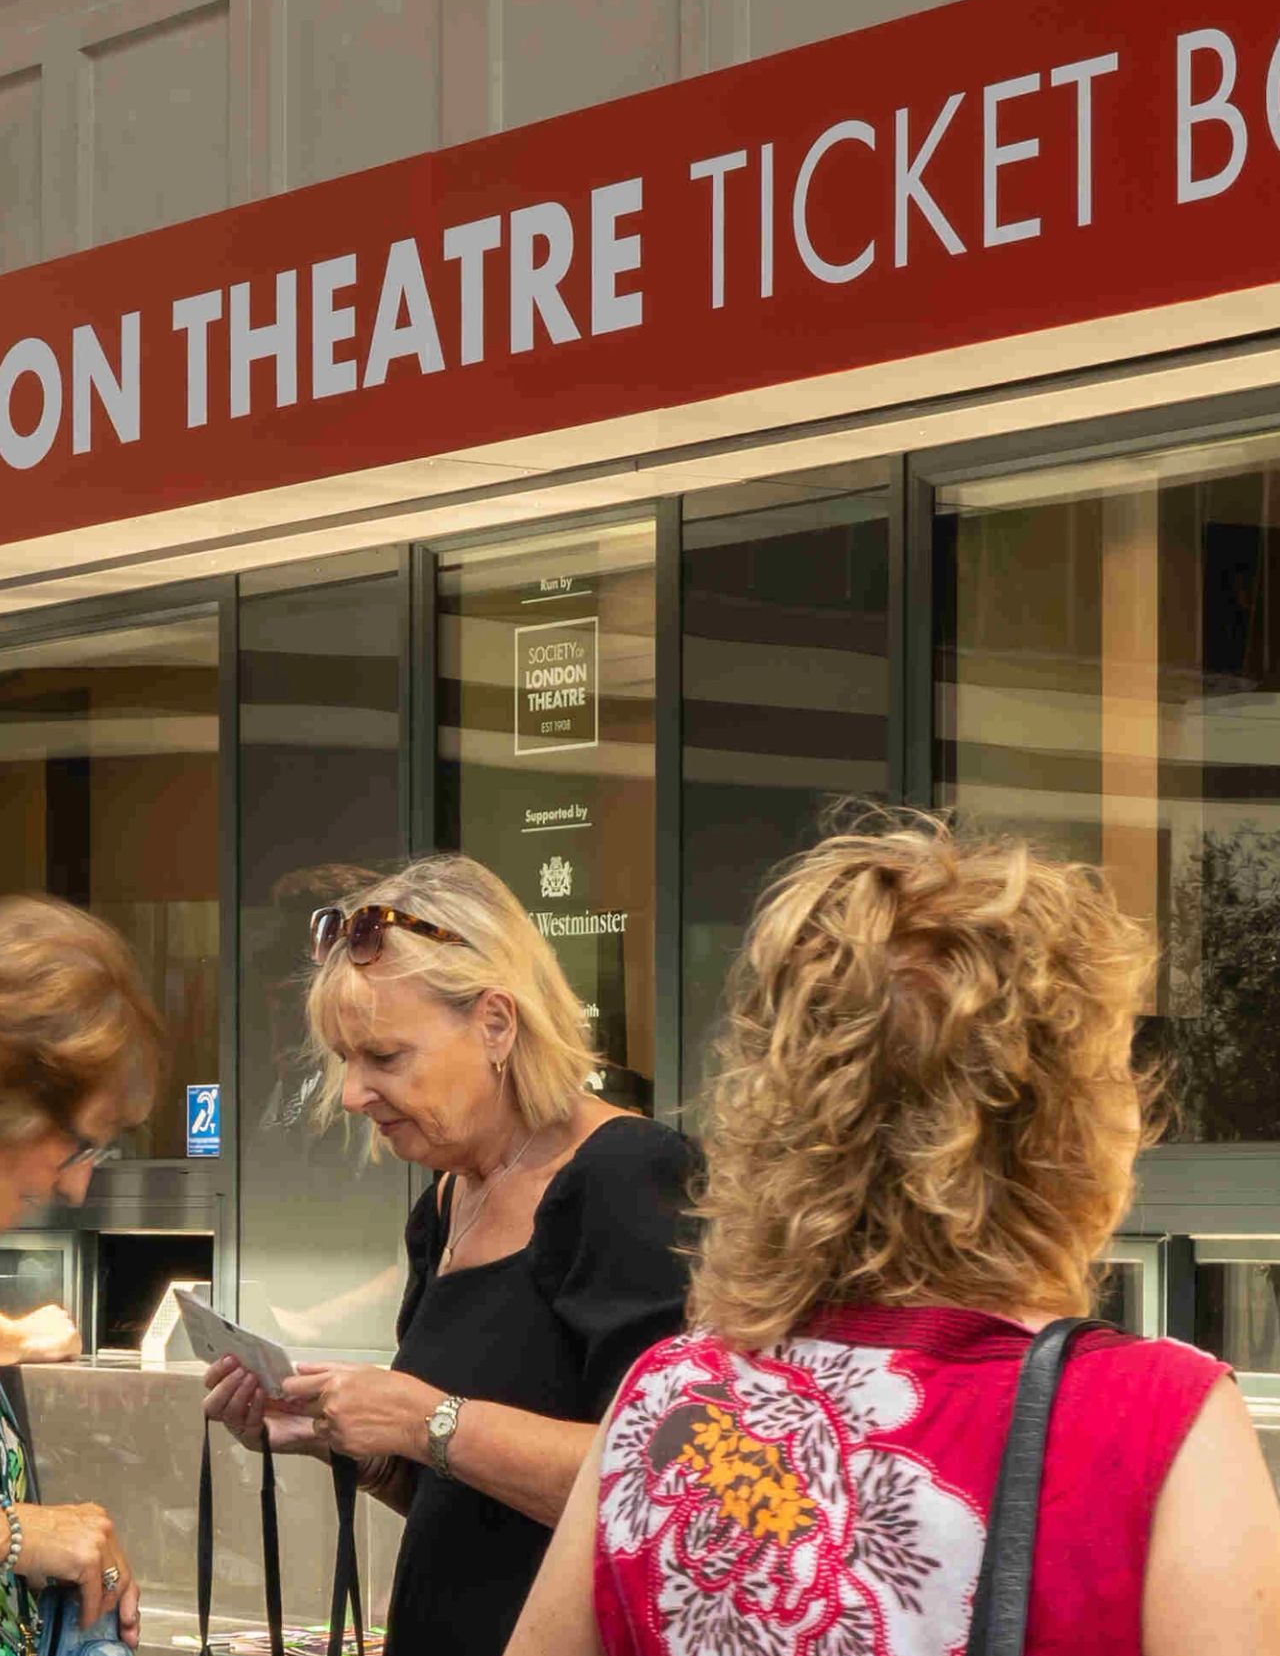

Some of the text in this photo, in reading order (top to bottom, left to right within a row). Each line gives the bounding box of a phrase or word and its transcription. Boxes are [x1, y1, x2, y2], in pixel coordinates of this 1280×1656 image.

[172, 177, 643, 429] THEATRE
[690, 52, 1119, 309] TICKET
[540, 576, 573, 591] Run by
[528, 642, 577, 664] SOCIETY
[525, 663, 587, 690] LONDON
[527, 687, 586, 712] THEATRE
[540, 720, 553, 733] EST
[525, 804, 588, 825] Supported by
[536, 909, 628, 937] Westminster
